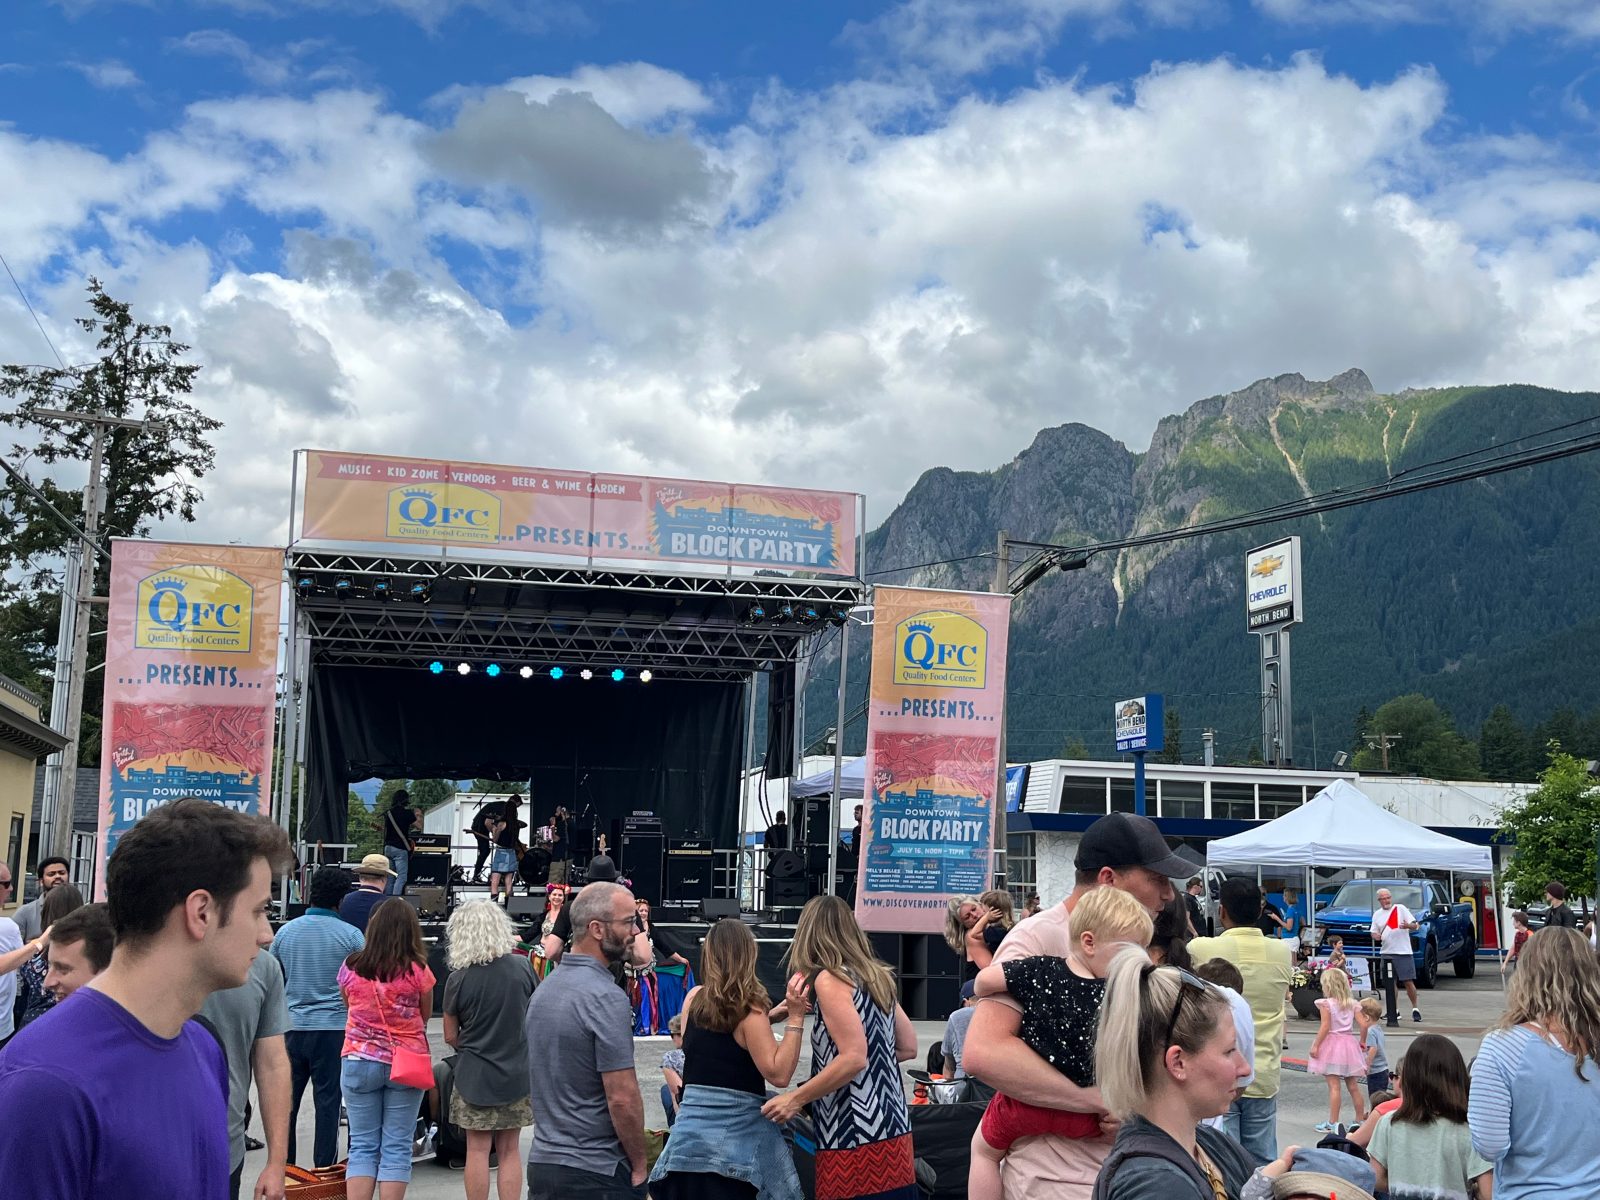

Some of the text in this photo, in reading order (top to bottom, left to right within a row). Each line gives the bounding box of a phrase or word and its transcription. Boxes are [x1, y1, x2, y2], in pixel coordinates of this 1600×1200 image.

[338, 464, 626, 495] MUSIC KID ZONE VENDORS BEER & WINE GARDEN
[399, 496, 489, 528] QFC
[399, 526, 489, 539] Quality Food Centers
[707, 525, 789, 538] DOWNTOWN
[671, 532, 822, 564] BLOCK PARTY
[1249, 584, 1287, 602] CHEVROLET
[148, 589, 241, 632] QFC
[1250, 608, 1288, 626] NORTH BEND
[148, 634, 240, 645] Quality Food Centers
[903, 632, 977, 670] QFC
[903, 671, 976, 682] Quality Food Centers
[153, 788, 221, 797] DOWNTOWN
[905, 808, 961, 817] DOWNTOWN
[881, 818, 983, 841] BLOCK PARTY
